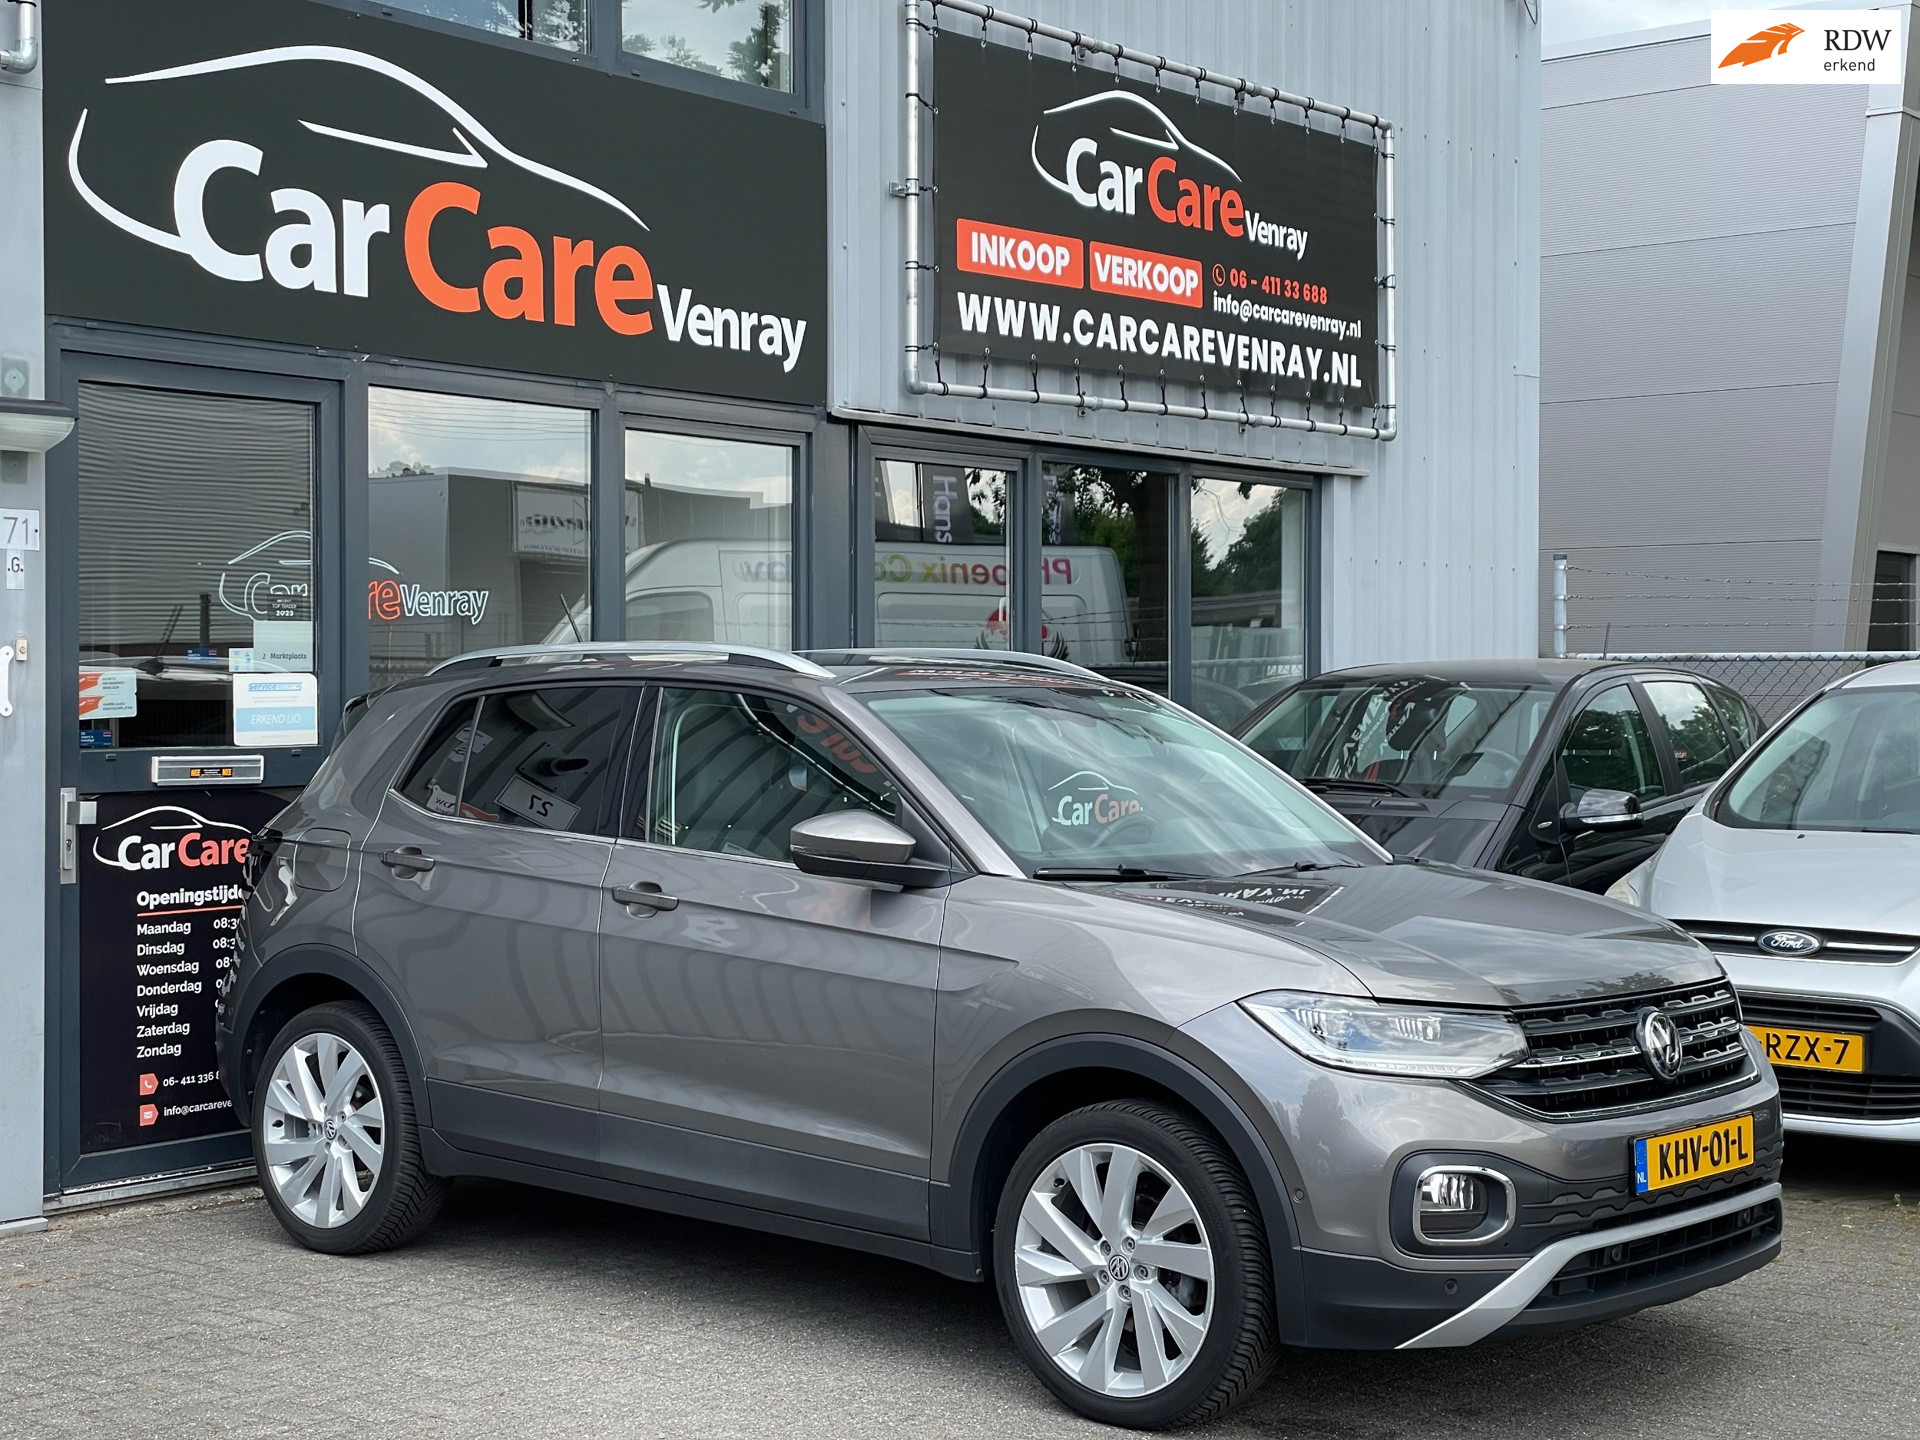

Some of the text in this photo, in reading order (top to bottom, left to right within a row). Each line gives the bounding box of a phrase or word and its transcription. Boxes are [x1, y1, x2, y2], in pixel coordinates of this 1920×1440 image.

[1245, 210, 1308, 260] Venray
[971, 231, 1199, 297] INKOOP VERKOOP
[1229, 268, 1247, 289] 06
[1261, 275, 1281, 296] 411
[1284, 279, 1300, 300] 33
[1303, 283, 1328, 305] 688
[1213, 290, 1362, 341] info@carcarevenray.nl
[656, 284, 807, 373] Venray
[957, 291, 1362, 388] WWW.CARCAREVENRAY.NL
[3, 516, 29, 545] 71
[400, 584, 489, 625] Venray
[137, 917, 240, 936] Maandag 08:3
[137, 942, 185, 956] Dinsdag
[1770, 933, 1805, 949] Ford
[137, 961, 199, 976] Woensdag
[137, 980, 202, 997] Donderdag
[137, 1003, 178, 1018] Vrijdag
[137, 1022, 190, 1037] Zaterdag
[137, 1043, 182, 1058] Zondag
[197, 1071, 214, 1084] 336
[1658, 1125, 1749, 1181] KHV-01-L
[1636, 1171, 1647, 1184] NL
